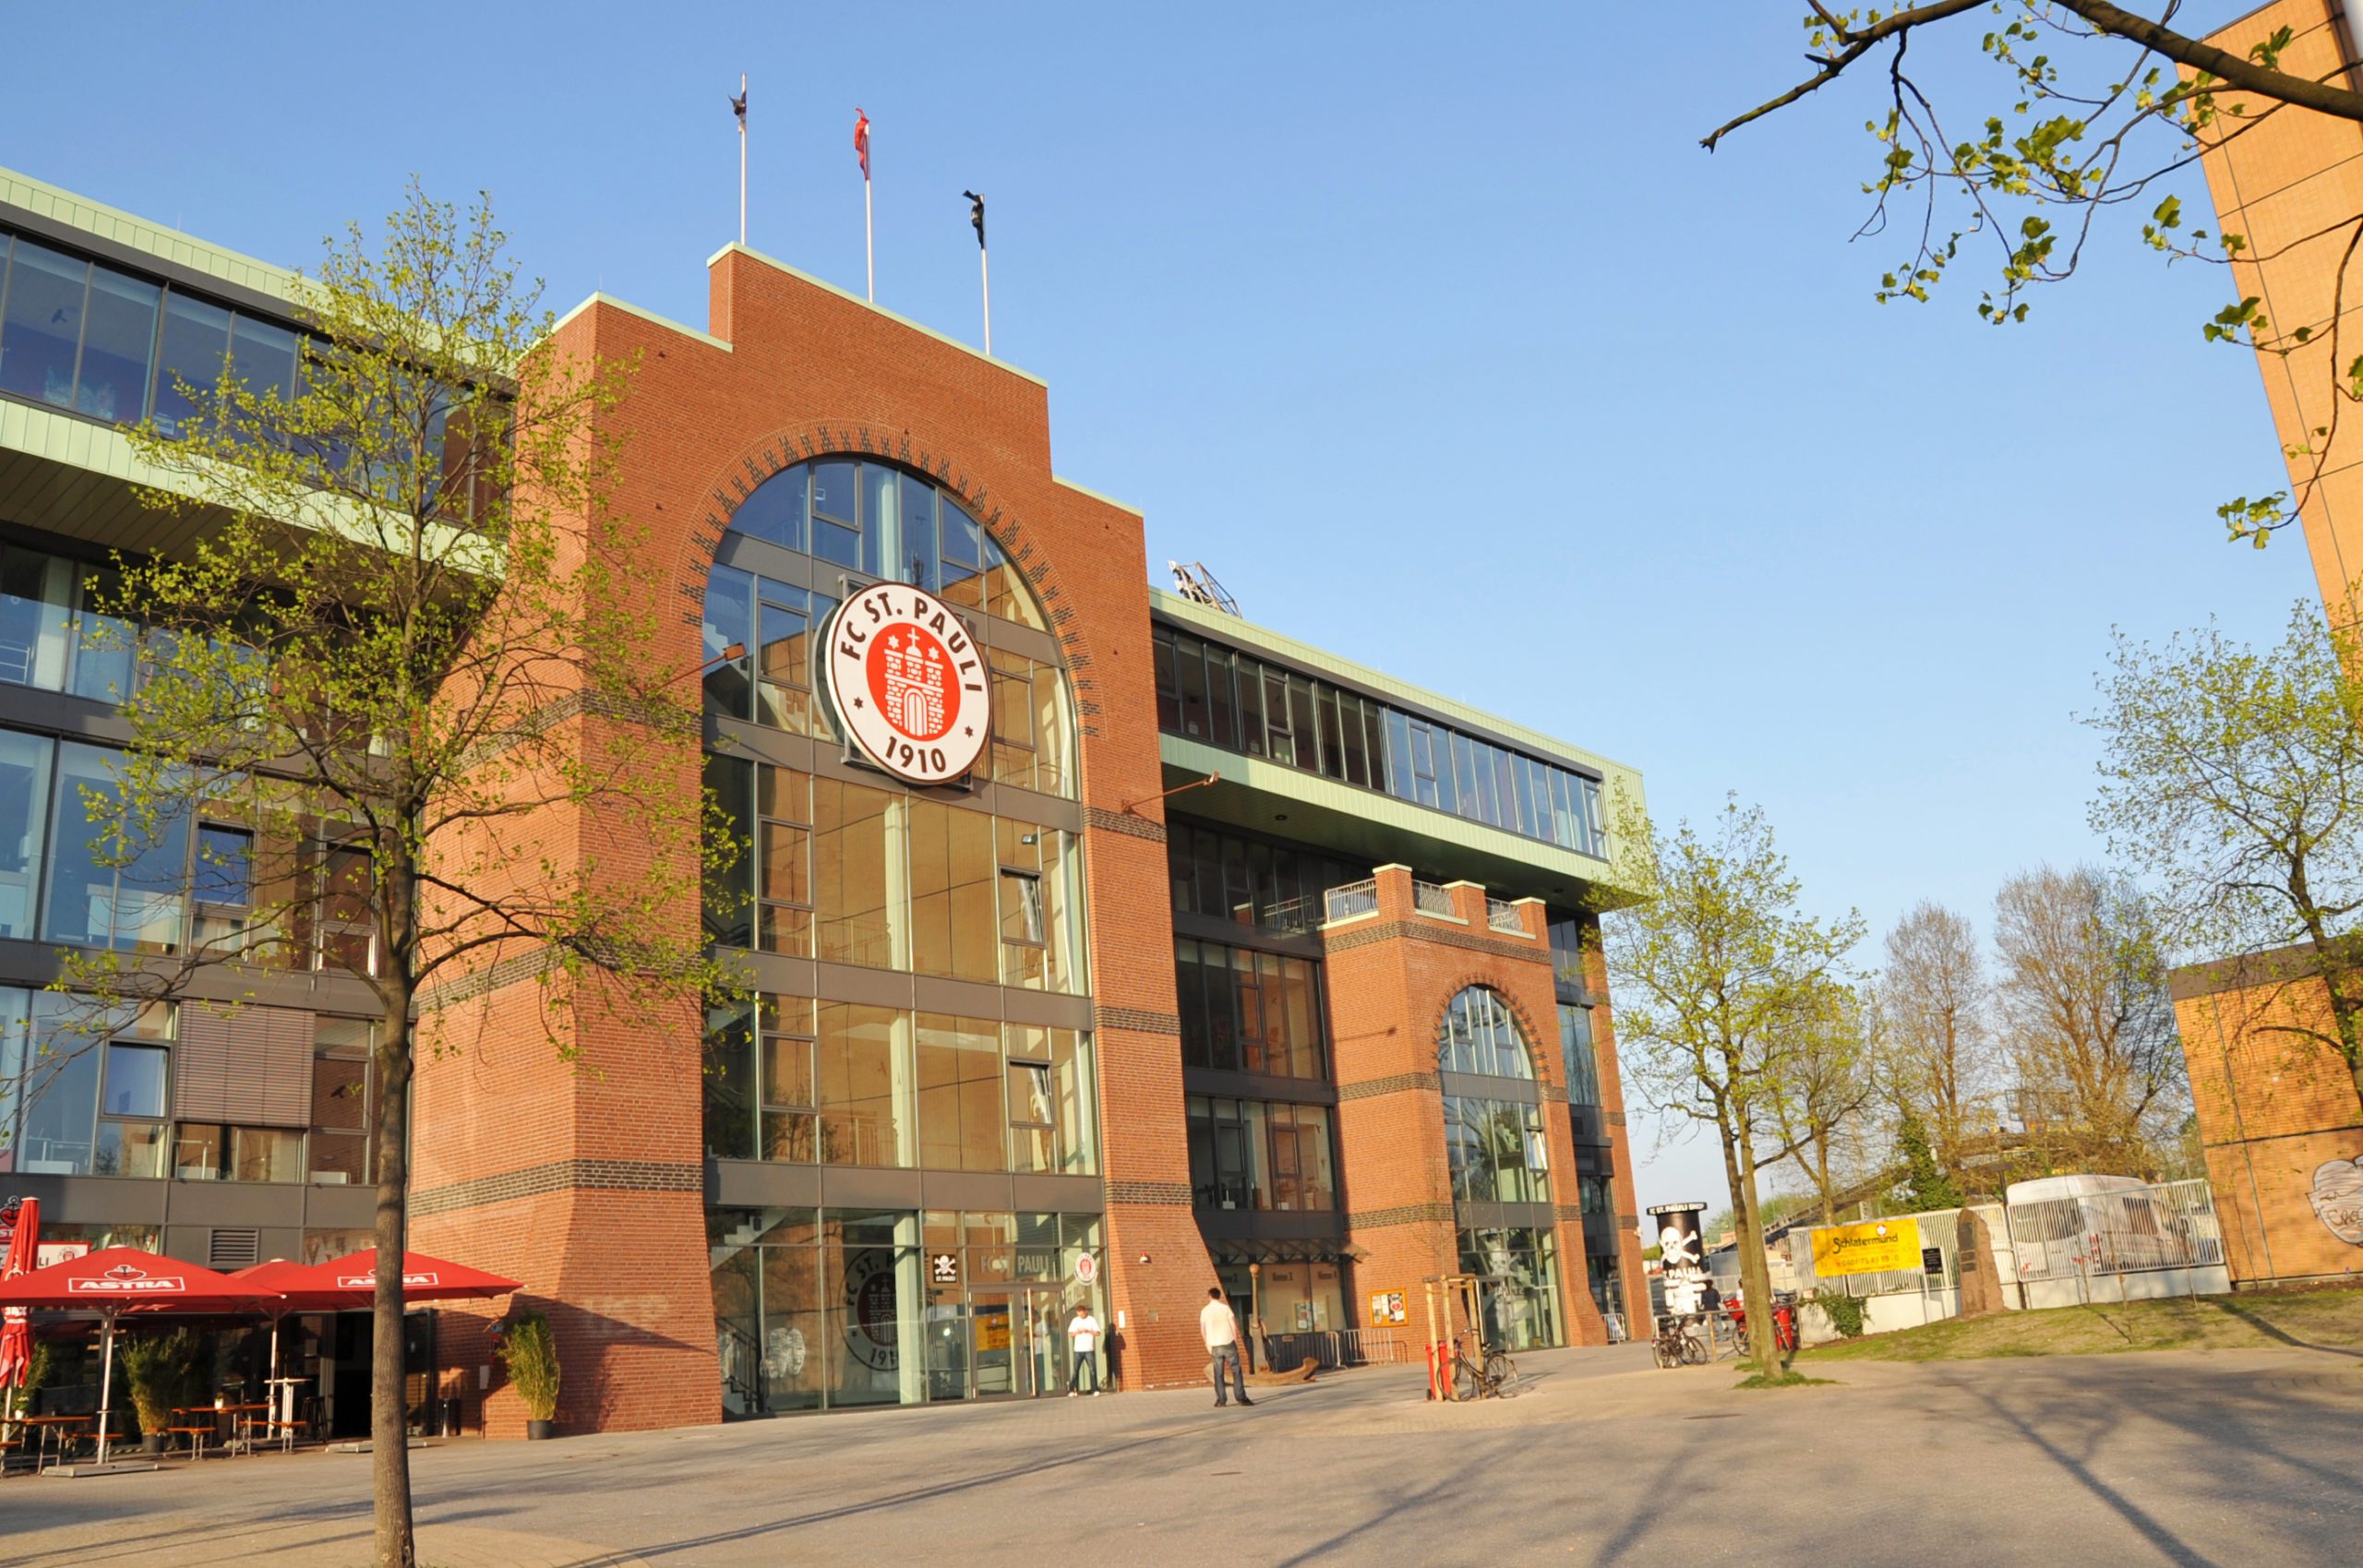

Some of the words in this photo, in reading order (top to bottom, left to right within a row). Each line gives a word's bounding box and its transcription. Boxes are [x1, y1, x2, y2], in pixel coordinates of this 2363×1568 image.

[841, 620, 867, 661] FC
[864, 592, 903, 624] ST.
[914, 596, 982, 692] PAULI
[885, 736, 946, 773] 1910
[1018, 1255, 1050, 1273] PAULI
[79, 1280, 175, 1289] ASTRA
